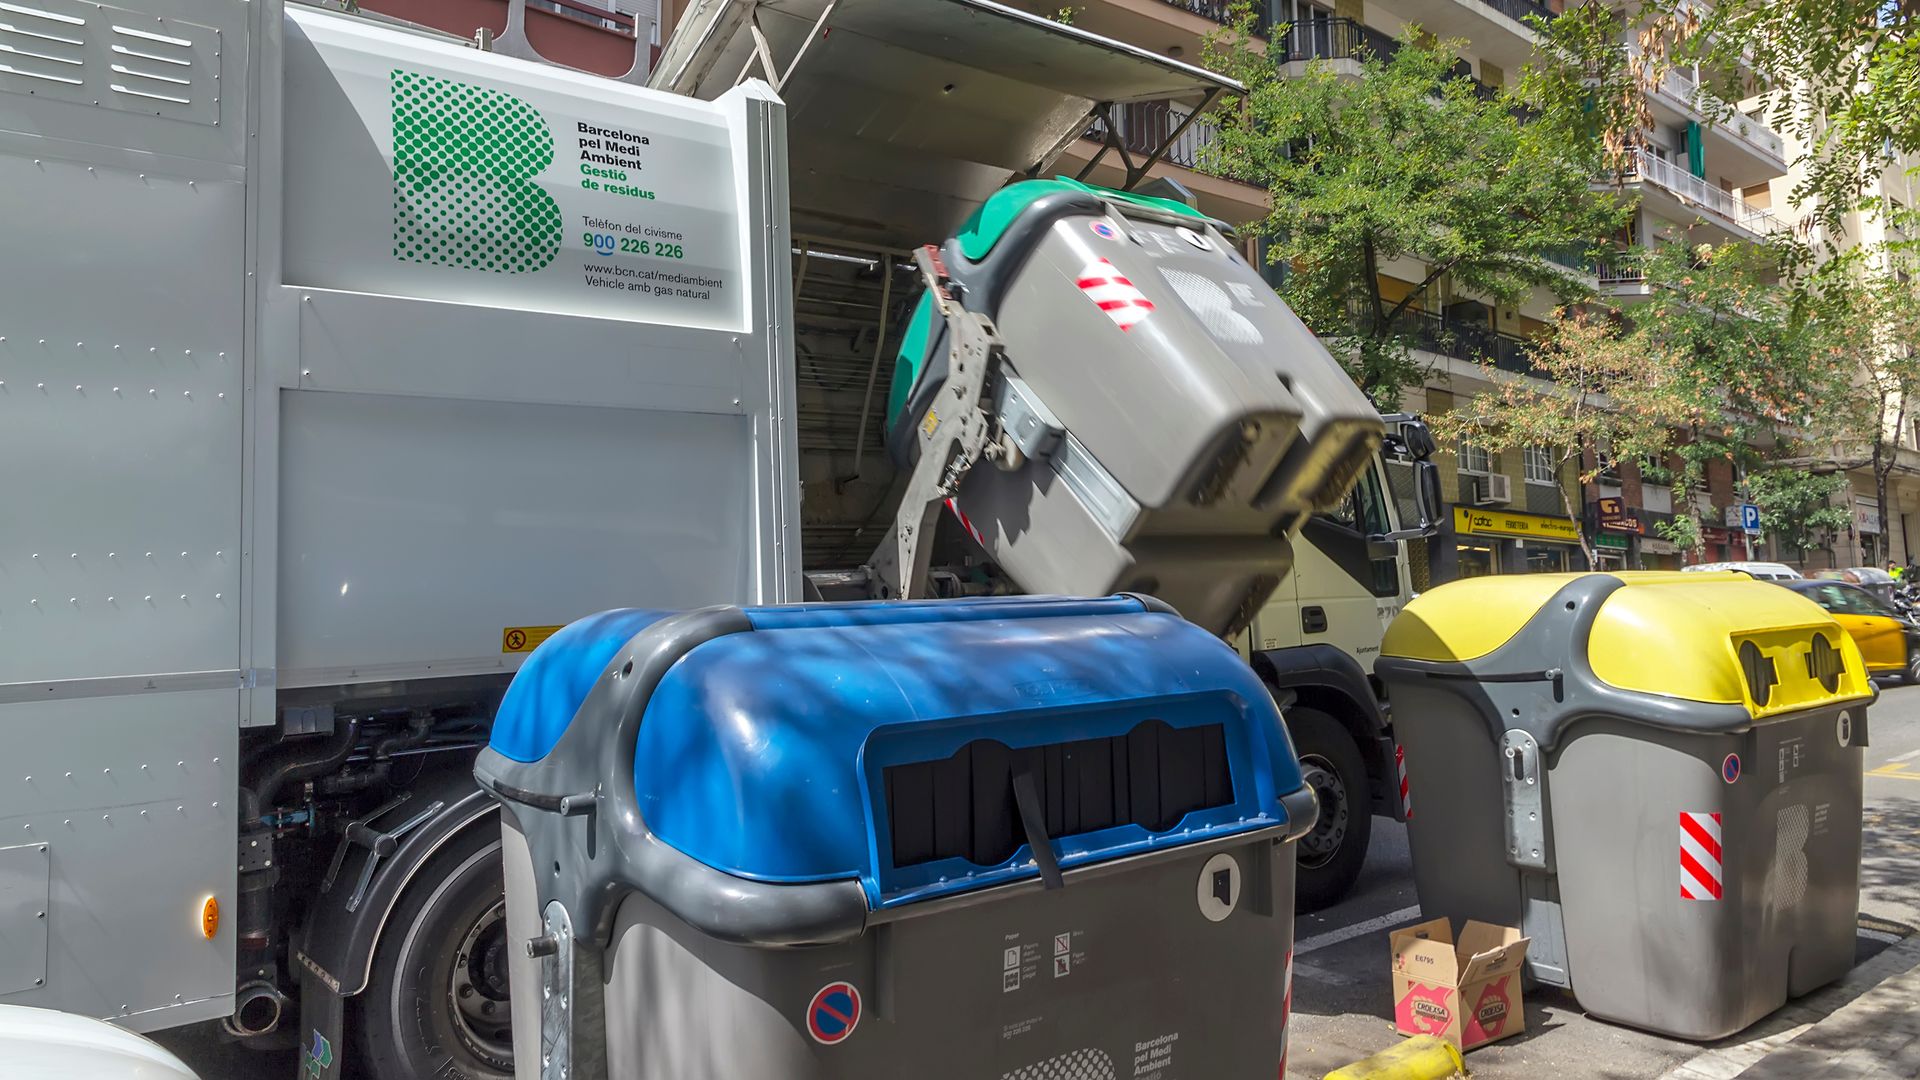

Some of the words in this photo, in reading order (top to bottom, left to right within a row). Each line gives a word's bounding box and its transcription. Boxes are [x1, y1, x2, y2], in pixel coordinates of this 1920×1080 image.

[577, 121, 650, 146] Barcelona
[578, 136, 604, 153] pel
[605, 140, 641, 157] Medi
[580, 151, 642, 170] Ambient
[580, 163, 627, 182] Gestió
[581, 178, 600, 191] de
[603, 183, 656, 200] residus
[582, 215, 622, 232] Telèfon
[624, 221, 641, 235] del
[644, 225, 684, 241] civisme
[583, 232, 616, 251] 900
[620, 238, 650, 255] 226
[654, 242, 684, 259] 226
[583, 263, 724, 289] www.bcn.cat/mediambient
[584, 274, 625, 290] Vehicle
[627, 281, 651, 294] amb
[653, 286, 673, 298] gas
[675, 286, 711, 300] natural
[1745, 507, 1756, 527] P
[1135, 1032, 1179, 1053] Barcelona
[1133, 1055, 1171, 1077] Ambient
[1134, 1050, 1149, 1067] pel
[1150, 1043, 1172, 1059] Medi
